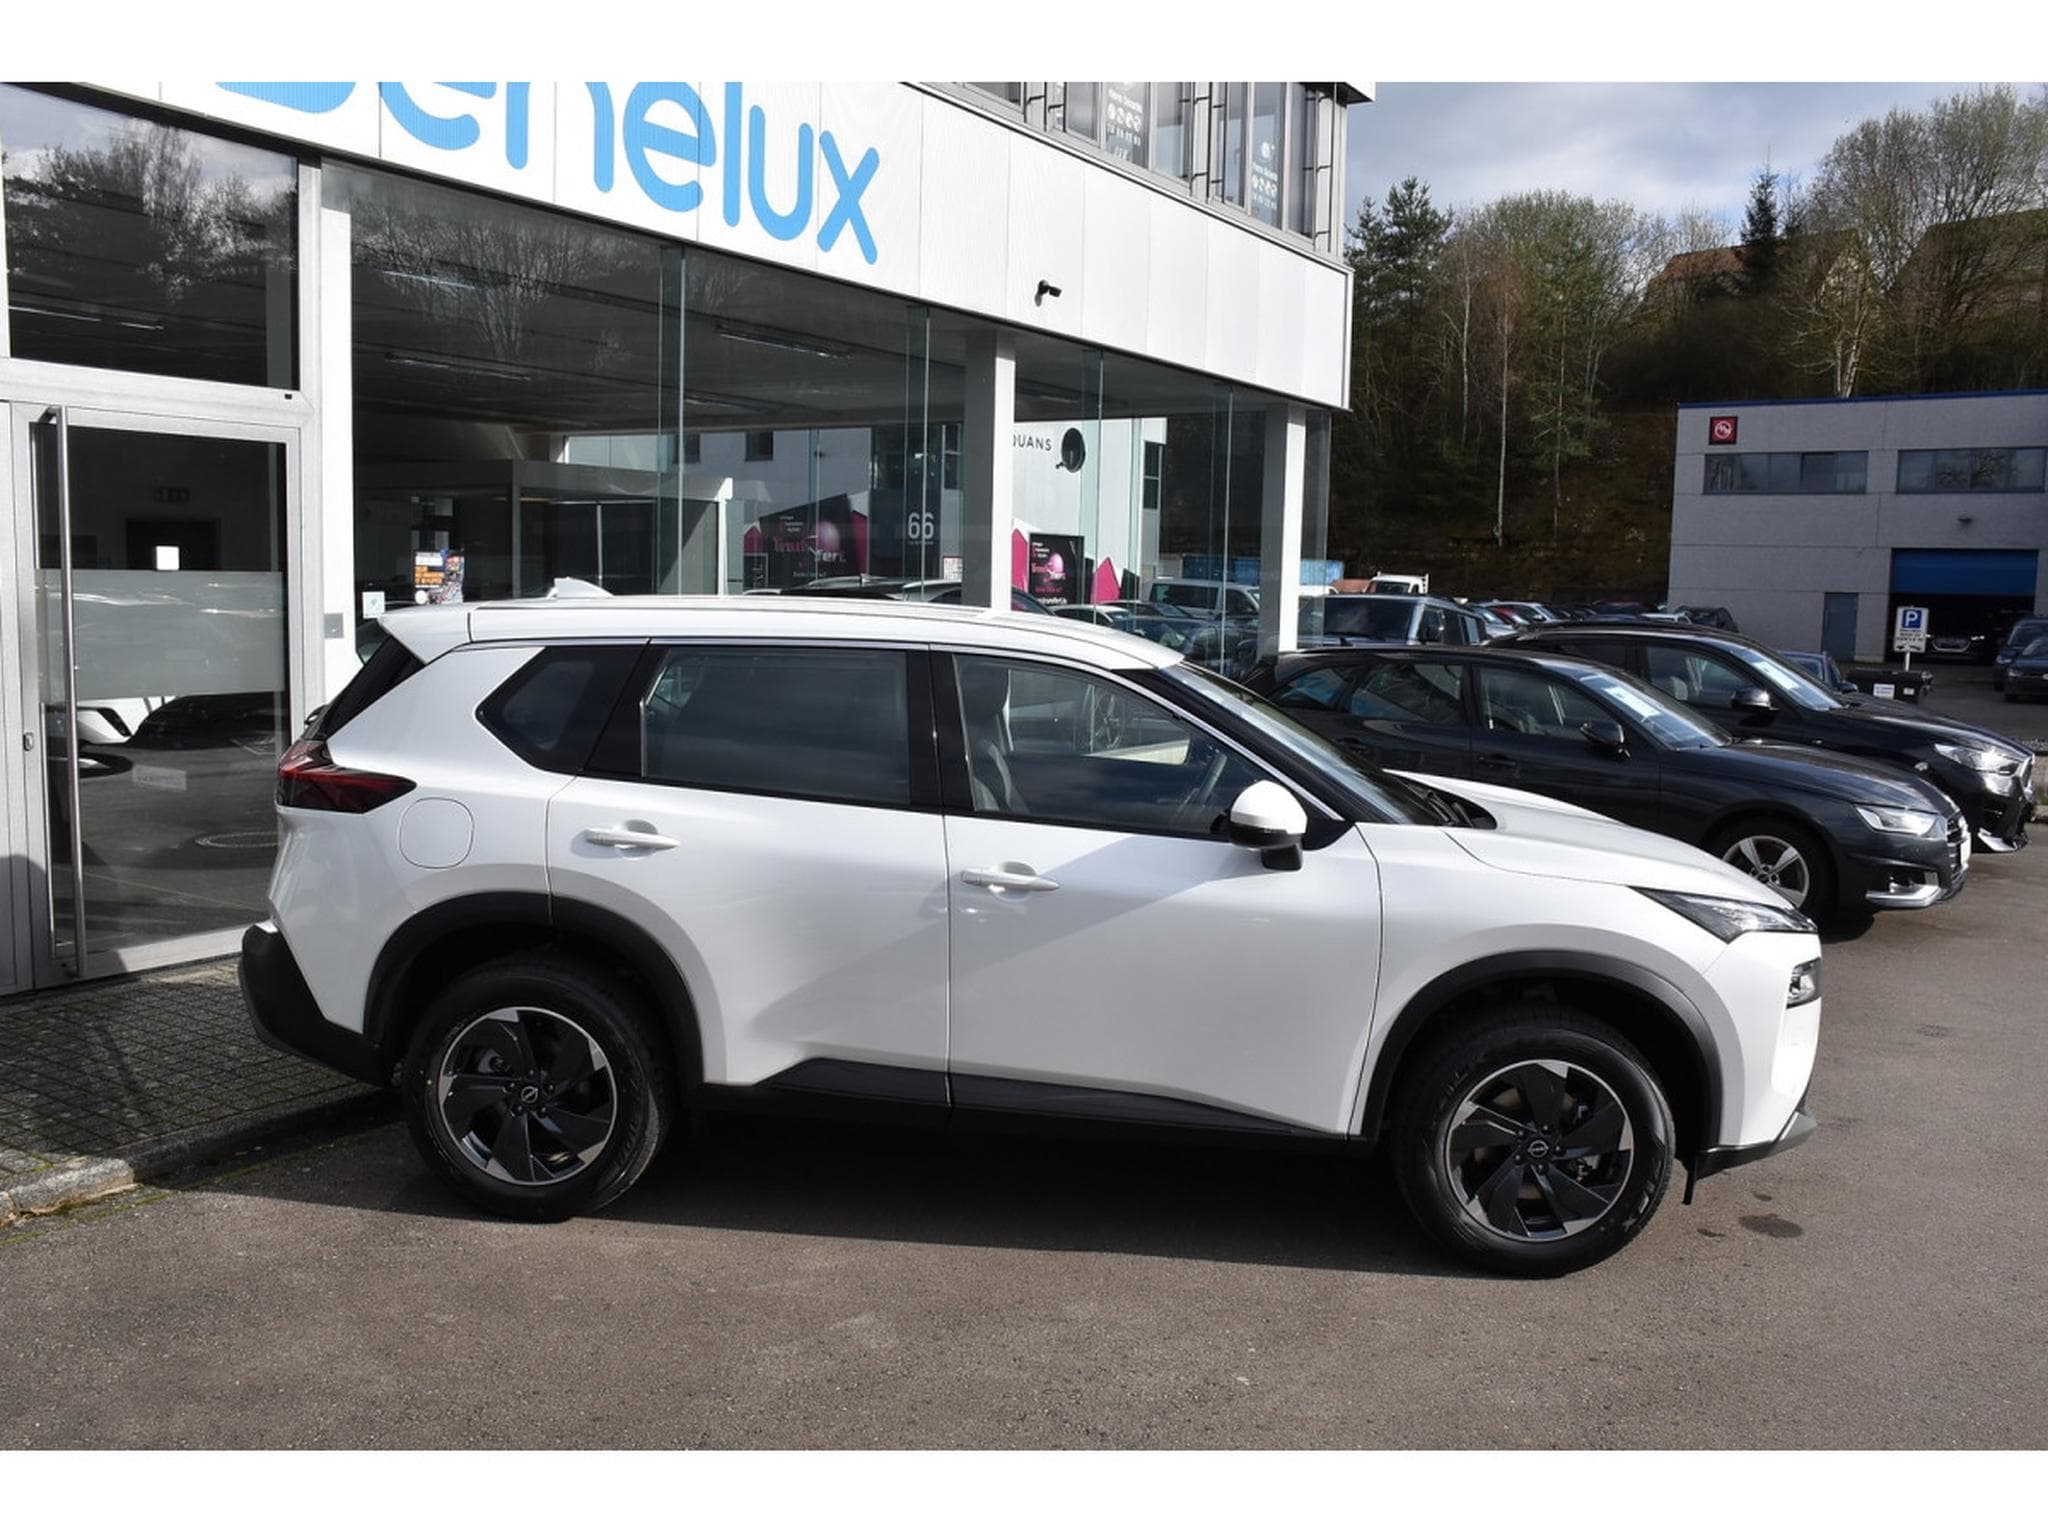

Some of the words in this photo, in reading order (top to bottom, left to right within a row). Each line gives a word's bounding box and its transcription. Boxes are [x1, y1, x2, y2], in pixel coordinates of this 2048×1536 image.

[216, 82, 880, 264] enelux
[1013, 433, 1053, 452] UANS
[907, 511, 935, 540] 66
[1905, 611, 1918, 627] P
